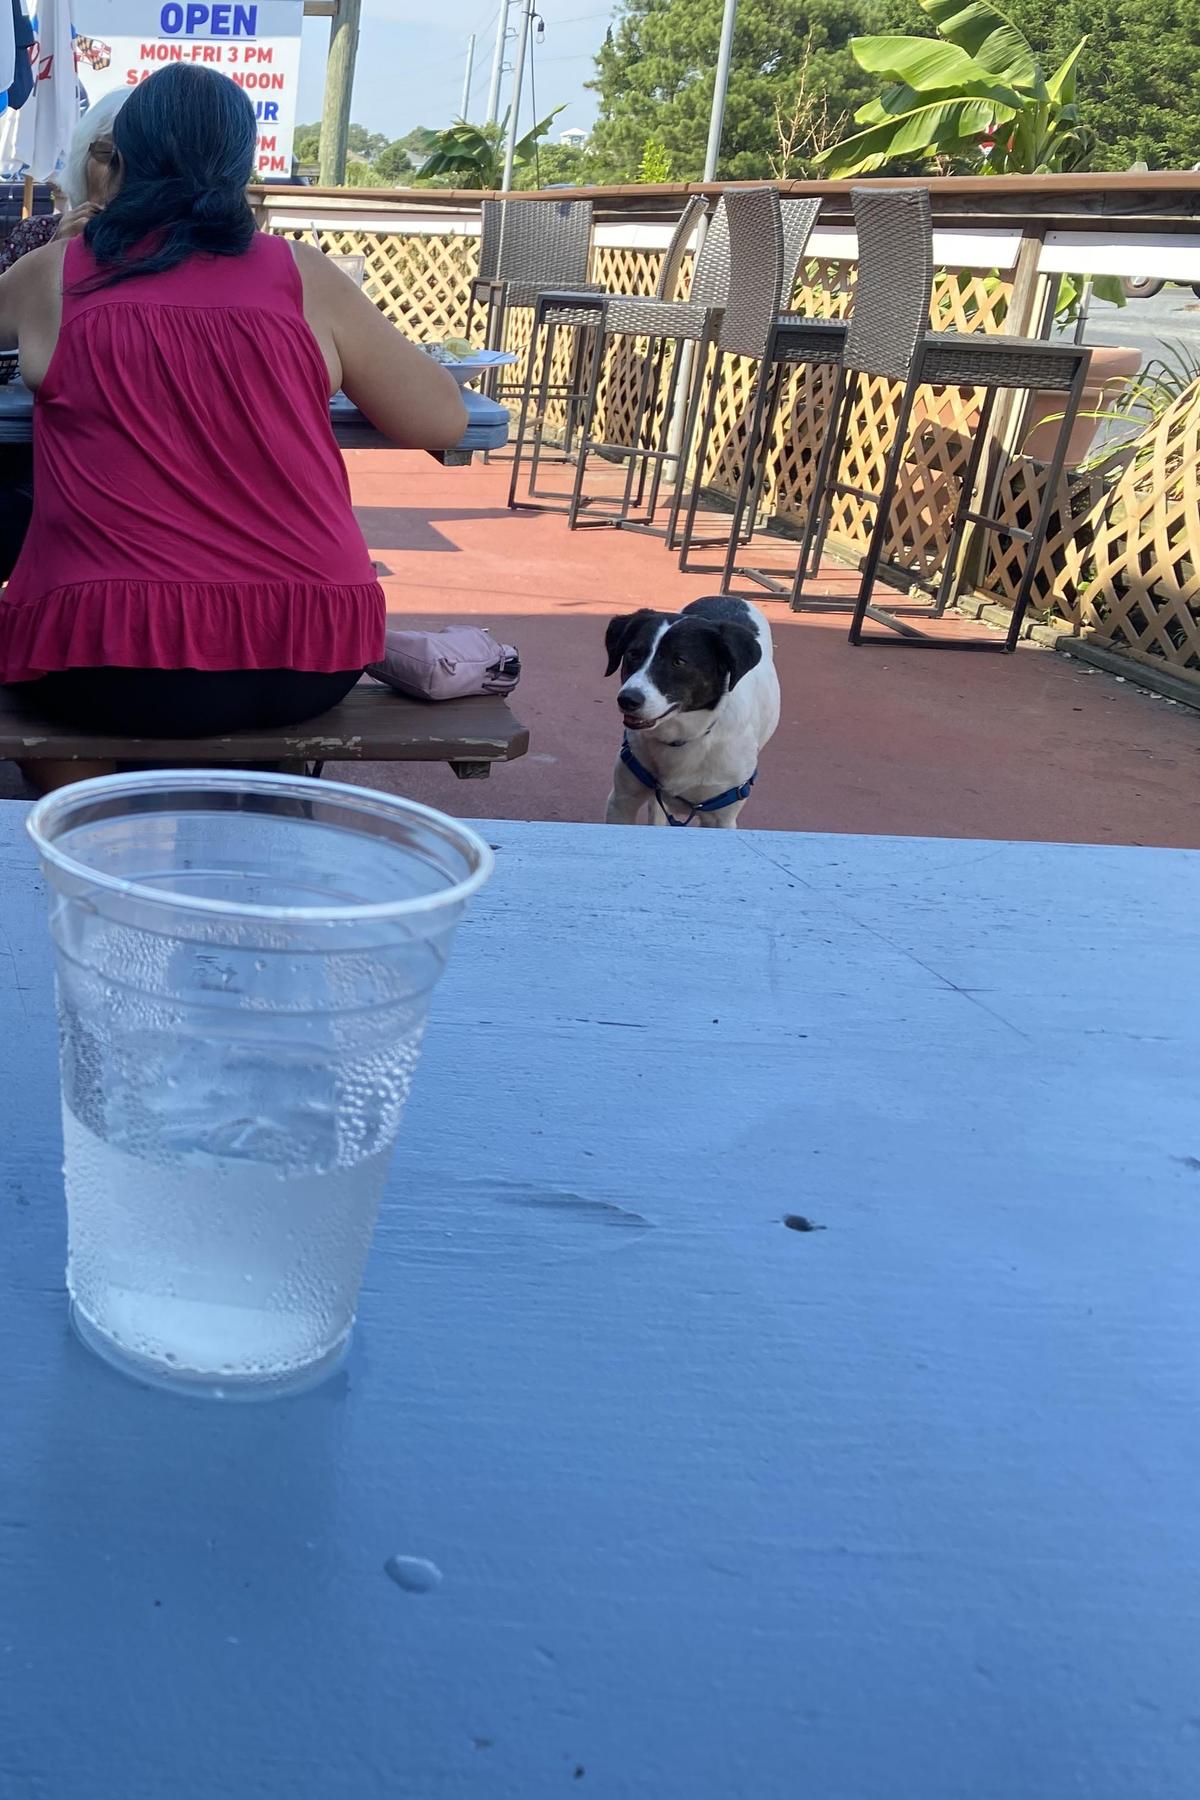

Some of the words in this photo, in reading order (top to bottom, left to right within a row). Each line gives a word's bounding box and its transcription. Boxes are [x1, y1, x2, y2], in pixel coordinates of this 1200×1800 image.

[160, 2, 257, 36] OPEN
[140, 44, 222, 62] MON-FRI
[227, 46, 238, 63] 3
[244, 47, 273, 64] PM
[232, 72, 284, 89] NOON
[258, 156, 285, 172] PM
